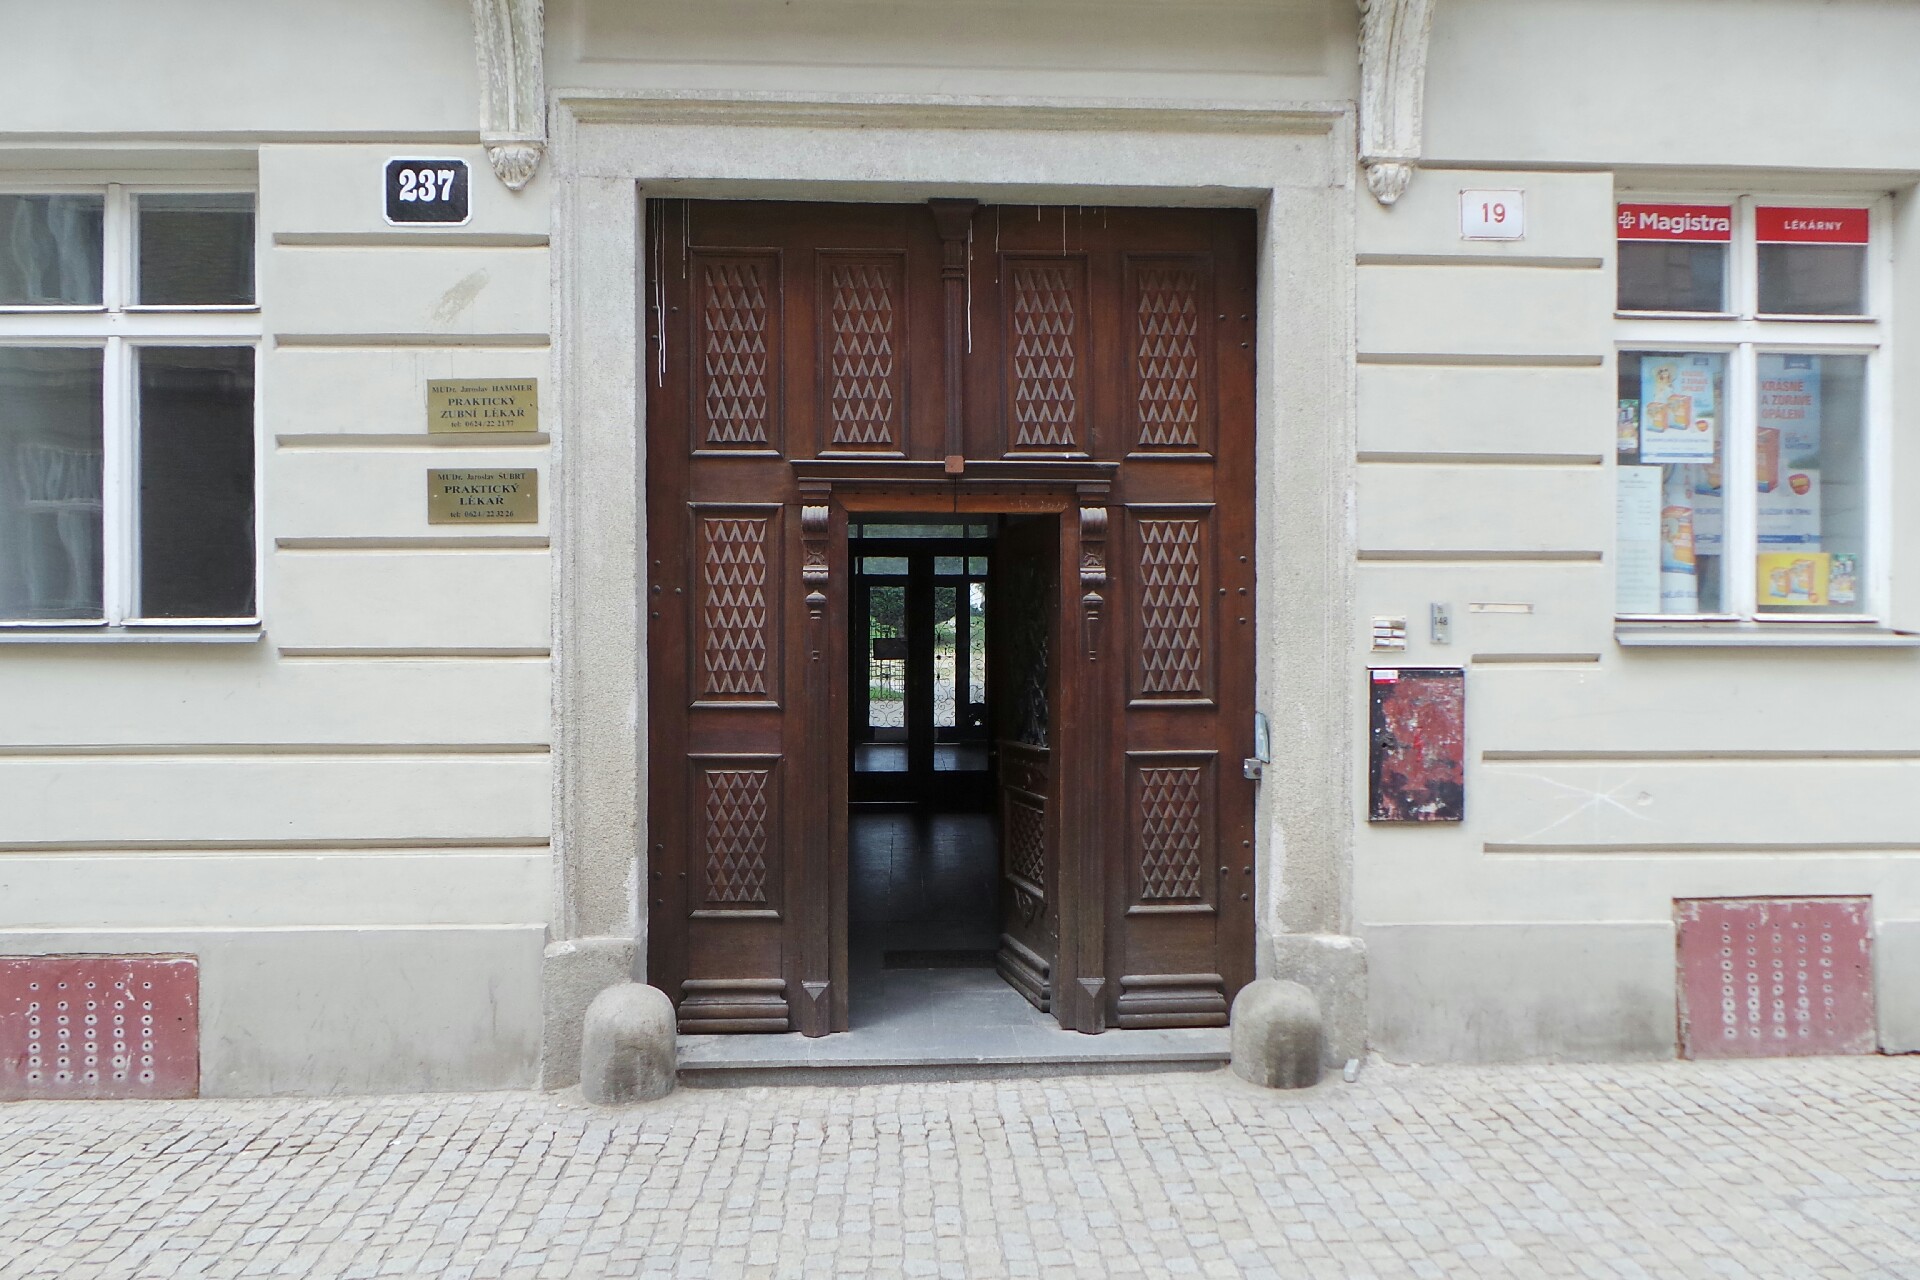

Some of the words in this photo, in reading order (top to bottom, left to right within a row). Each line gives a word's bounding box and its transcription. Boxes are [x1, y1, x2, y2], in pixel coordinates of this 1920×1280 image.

[399, 168, 455, 202] 237
[1482, 203, 1506, 223] 19
[1639, 212, 1730, 234] Magistra
[1783, 218, 1843, 231] LÉKÁRNY
[492, 384, 532, 392] HAMMER
[448, 395, 515, 406] PRAKTICKÝ
[440, 408, 477, 419] ZUBNÍ
[484, 407, 525, 418] LÉKAŘ
[438, 473, 463, 481] MUDr.
[444, 483, 519, 494] PRAKTICKÝ
[460, 495, 504, 506] LÉKAŘ
